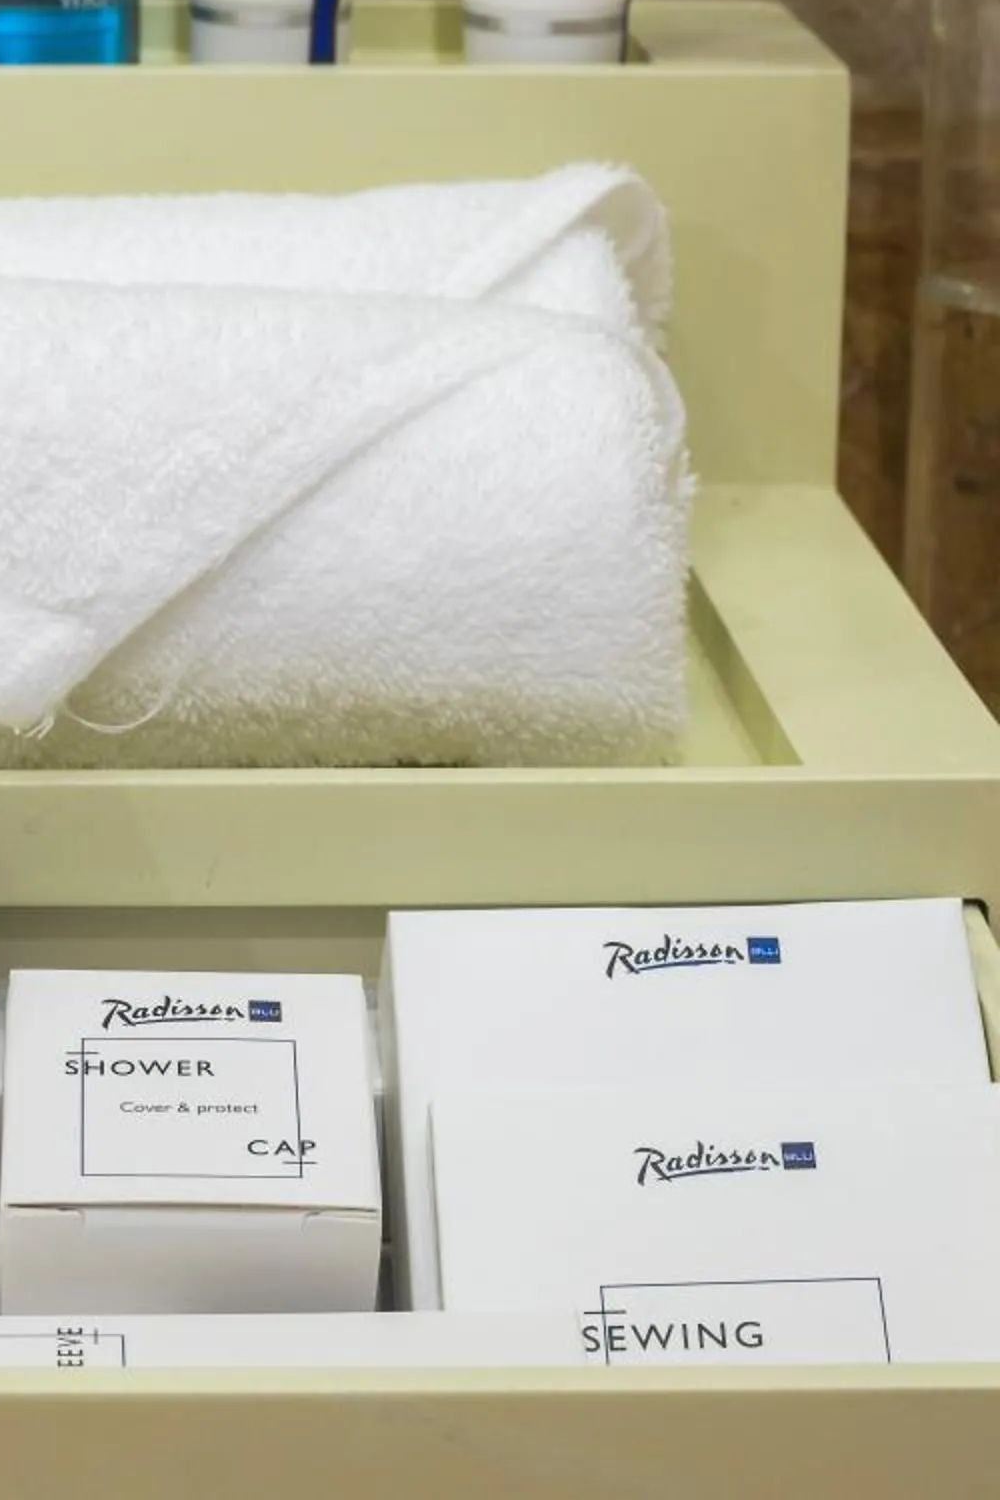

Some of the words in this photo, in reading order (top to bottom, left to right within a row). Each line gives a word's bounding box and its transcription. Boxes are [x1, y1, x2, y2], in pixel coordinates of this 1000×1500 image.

[602, 934, 745, 980] Radisson
[101, 995, 245, 1030] Radisson
[64, 1059, 216, 1078] SHOWER
[119, 1101, 173, 1115] Cover
[177, 1101, 191, 1114] &
[196, 1102, 259, 1116] protect
[246, 1138, 318, 1157] CAP
[634, 1141, 780, 1186] Radisson
[580, 1320, 765, 1354] SEWING
